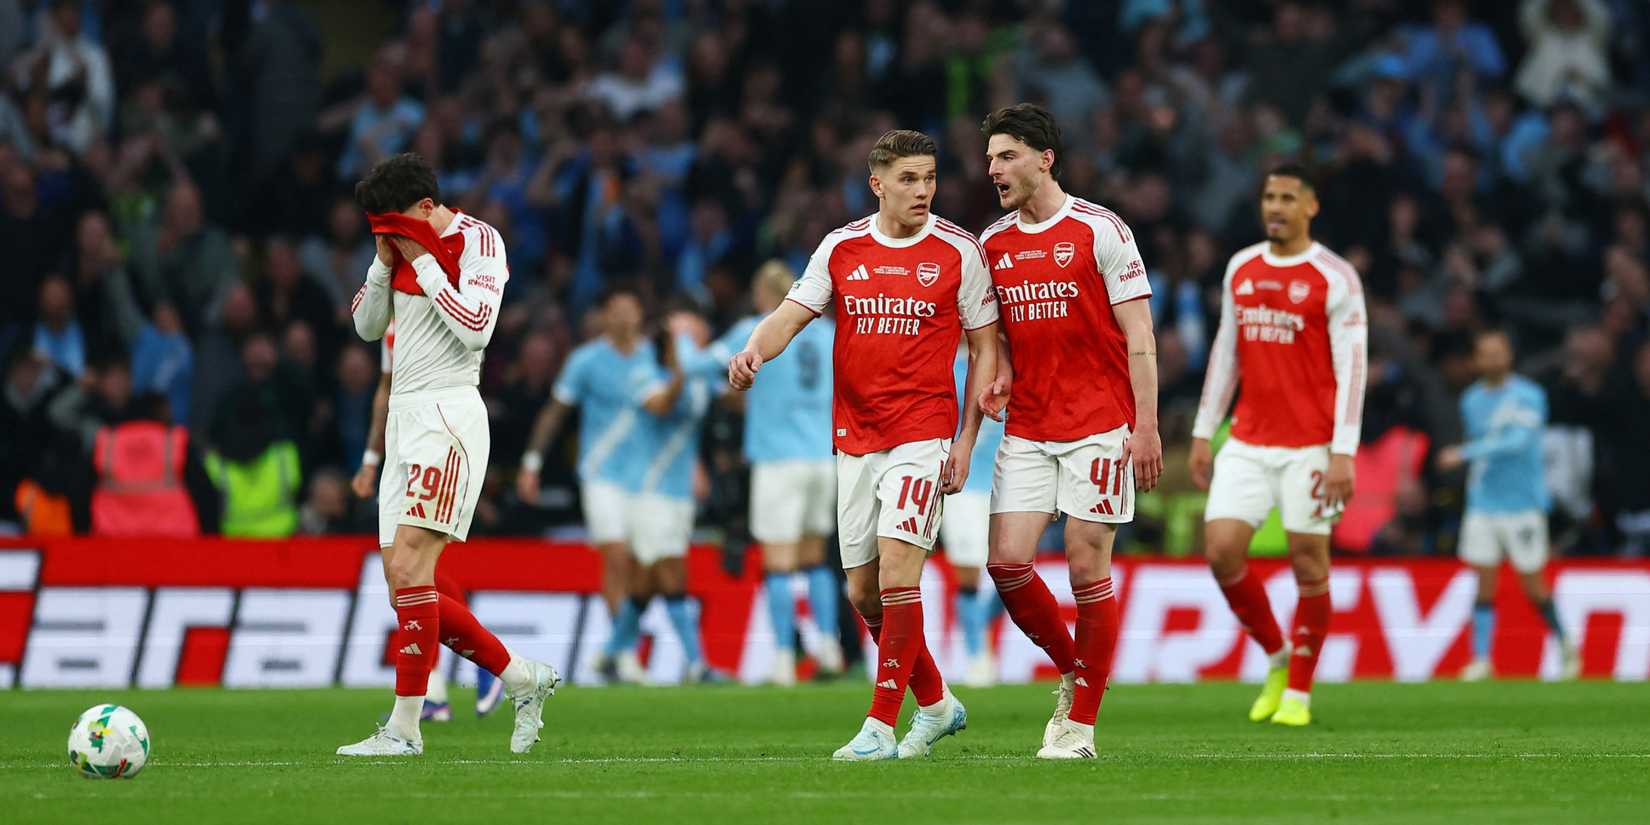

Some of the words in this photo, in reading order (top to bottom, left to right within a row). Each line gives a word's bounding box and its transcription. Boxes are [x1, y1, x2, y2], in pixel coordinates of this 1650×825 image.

[468, 279, 500, 296] RWANDA
[475, 274, 496, 284] VISIT
[996, 279, 1079, 304] Emirates
[844, 292, 937, 318] Emirates
[1010, 304, 1025, 322] FLY
[1028, 301, 1068, 321] BETTER
[856, 317, 873, 334] FLY
[877, 318, 920, 336] BETTER
[406, 463, 442, 501] 29
[1090, 457, 1123, 496] 41
[896, 475, 932, 516] 14
